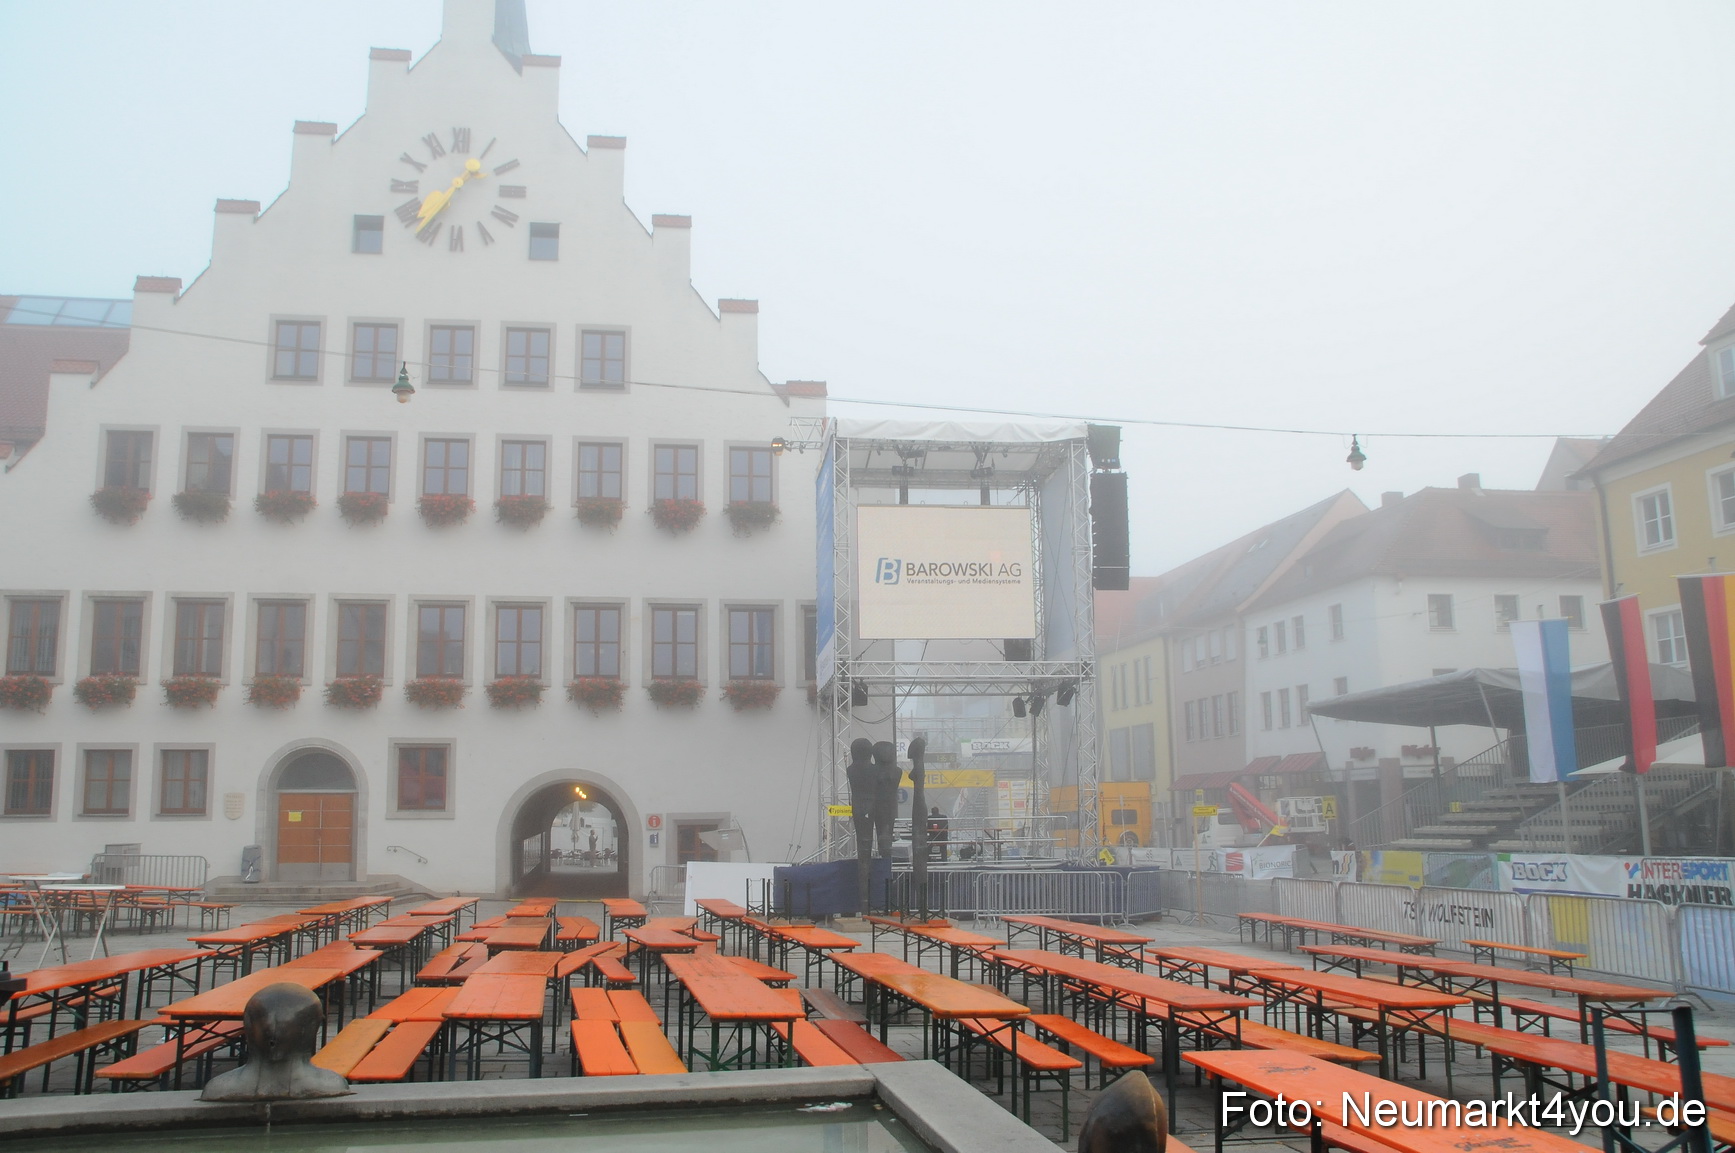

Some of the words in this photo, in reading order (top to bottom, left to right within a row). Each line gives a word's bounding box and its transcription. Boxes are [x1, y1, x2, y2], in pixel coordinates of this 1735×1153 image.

[906, 562, 993, 577] BAROWSKI
[997, 562, 1022, 577] AG
[906, 577, 957, 585] Veranstaltungs-
[959, 577, 971, 585] und
[972, 577, 1021, 586] Mediensysteme
[923, 774, 948, 785] IEL
[1325, 802, 1334, 814] A
[1512, 862, 1568, 881] BOCK
[1642, 862, 1729, 881] INTERSPORT
[1628, 883, 1733, 906] HACKNER
[1428, 903, 1494, 929] WOLFSTEIN
